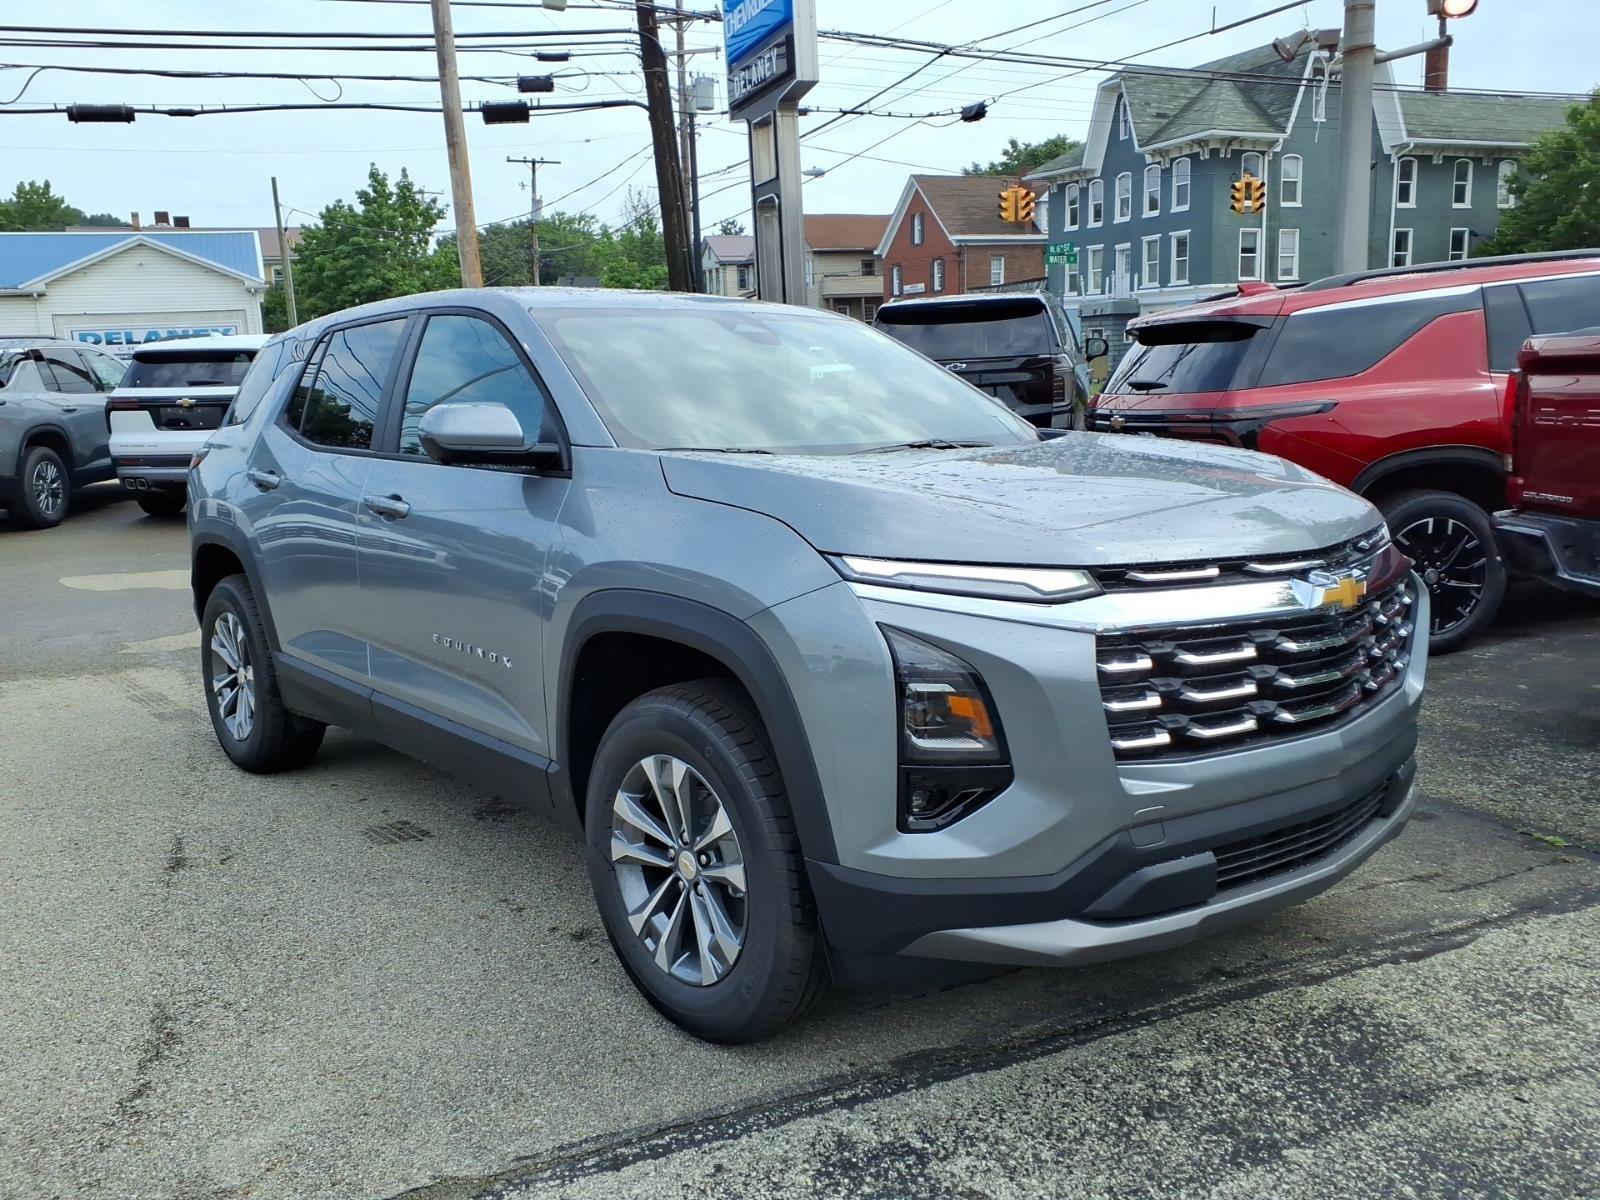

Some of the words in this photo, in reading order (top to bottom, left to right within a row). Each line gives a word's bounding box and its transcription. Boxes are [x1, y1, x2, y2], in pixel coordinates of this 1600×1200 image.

[725, 0, 775, 37] CHEVRO
[734, 47, 777, 97] DELANEY
[1049, 255, 1068, 264] WATER
[1063, 243, 1070, 252] ST
[432, 633, 513, 669] EQUINOX
